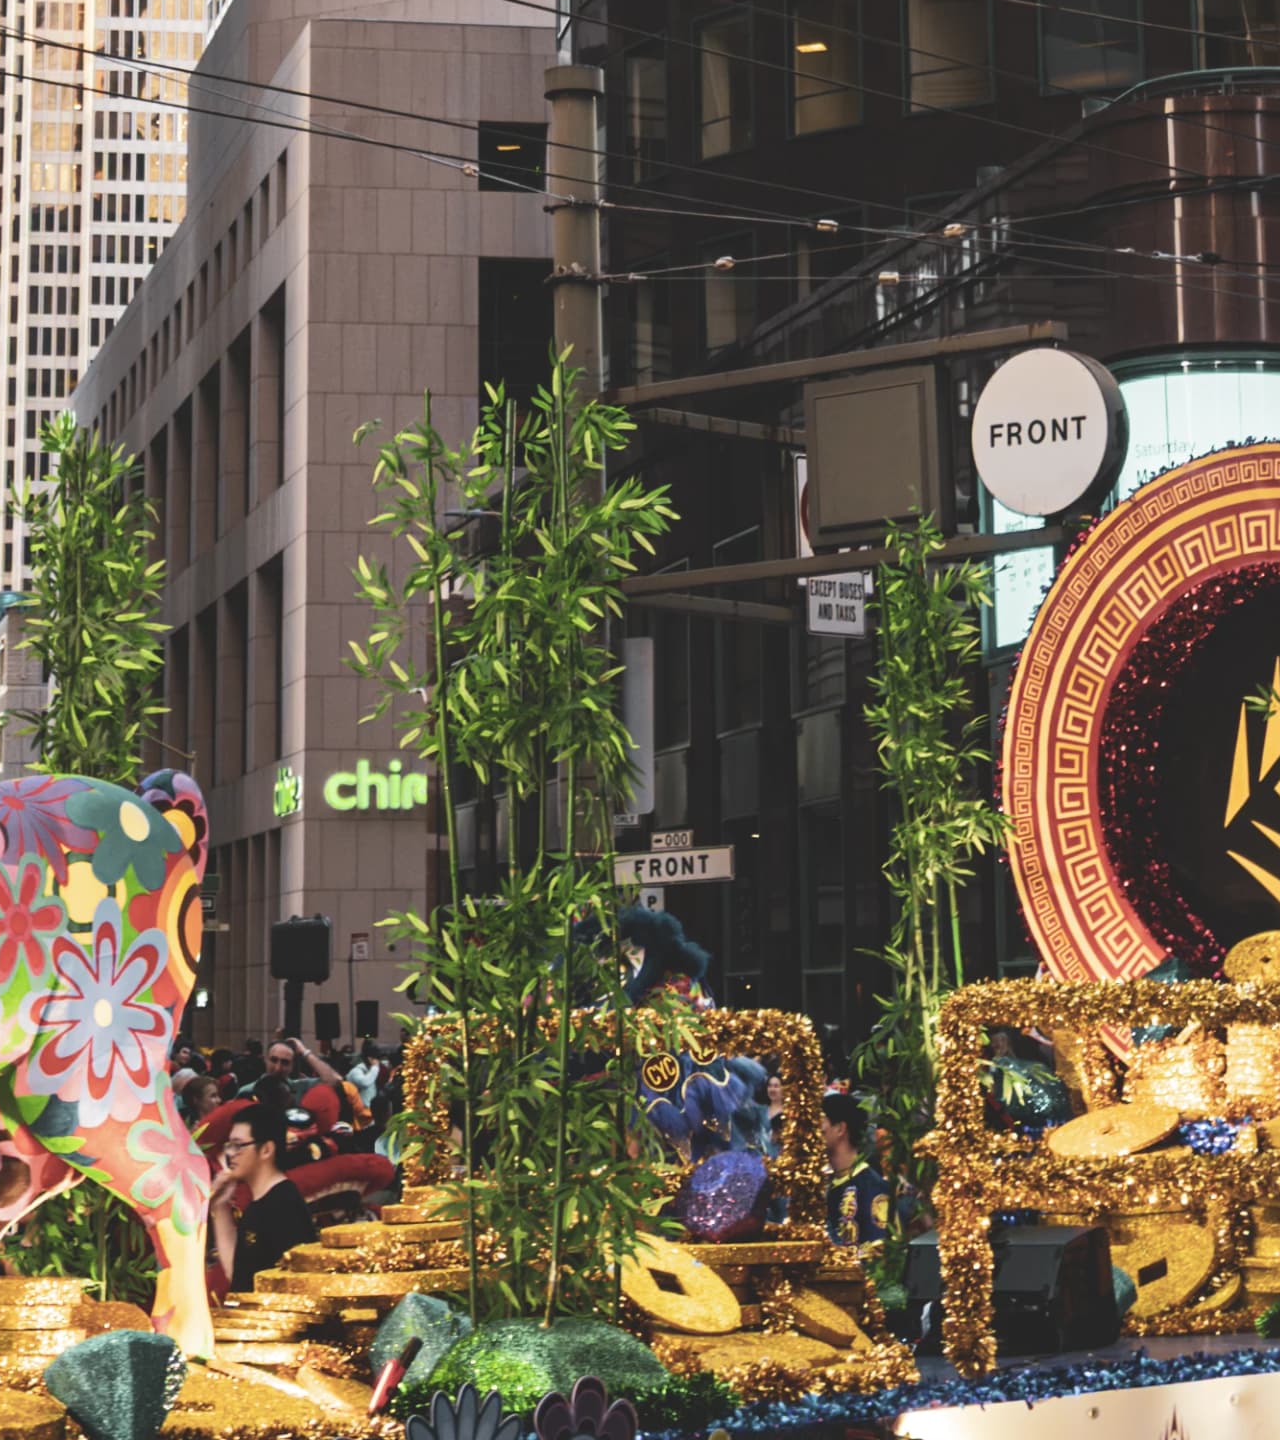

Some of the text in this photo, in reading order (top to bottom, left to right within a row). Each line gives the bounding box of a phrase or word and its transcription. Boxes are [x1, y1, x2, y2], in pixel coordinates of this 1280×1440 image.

[990, 416, 1087, 448] FRONT
[810, 579, 862, 600] EXCEPT BUSES
[818, 603, 857, 622] AND TAXIS
[634, 854, 709, 878] FRONT
[646, 1057, 676, 1085] CYC
